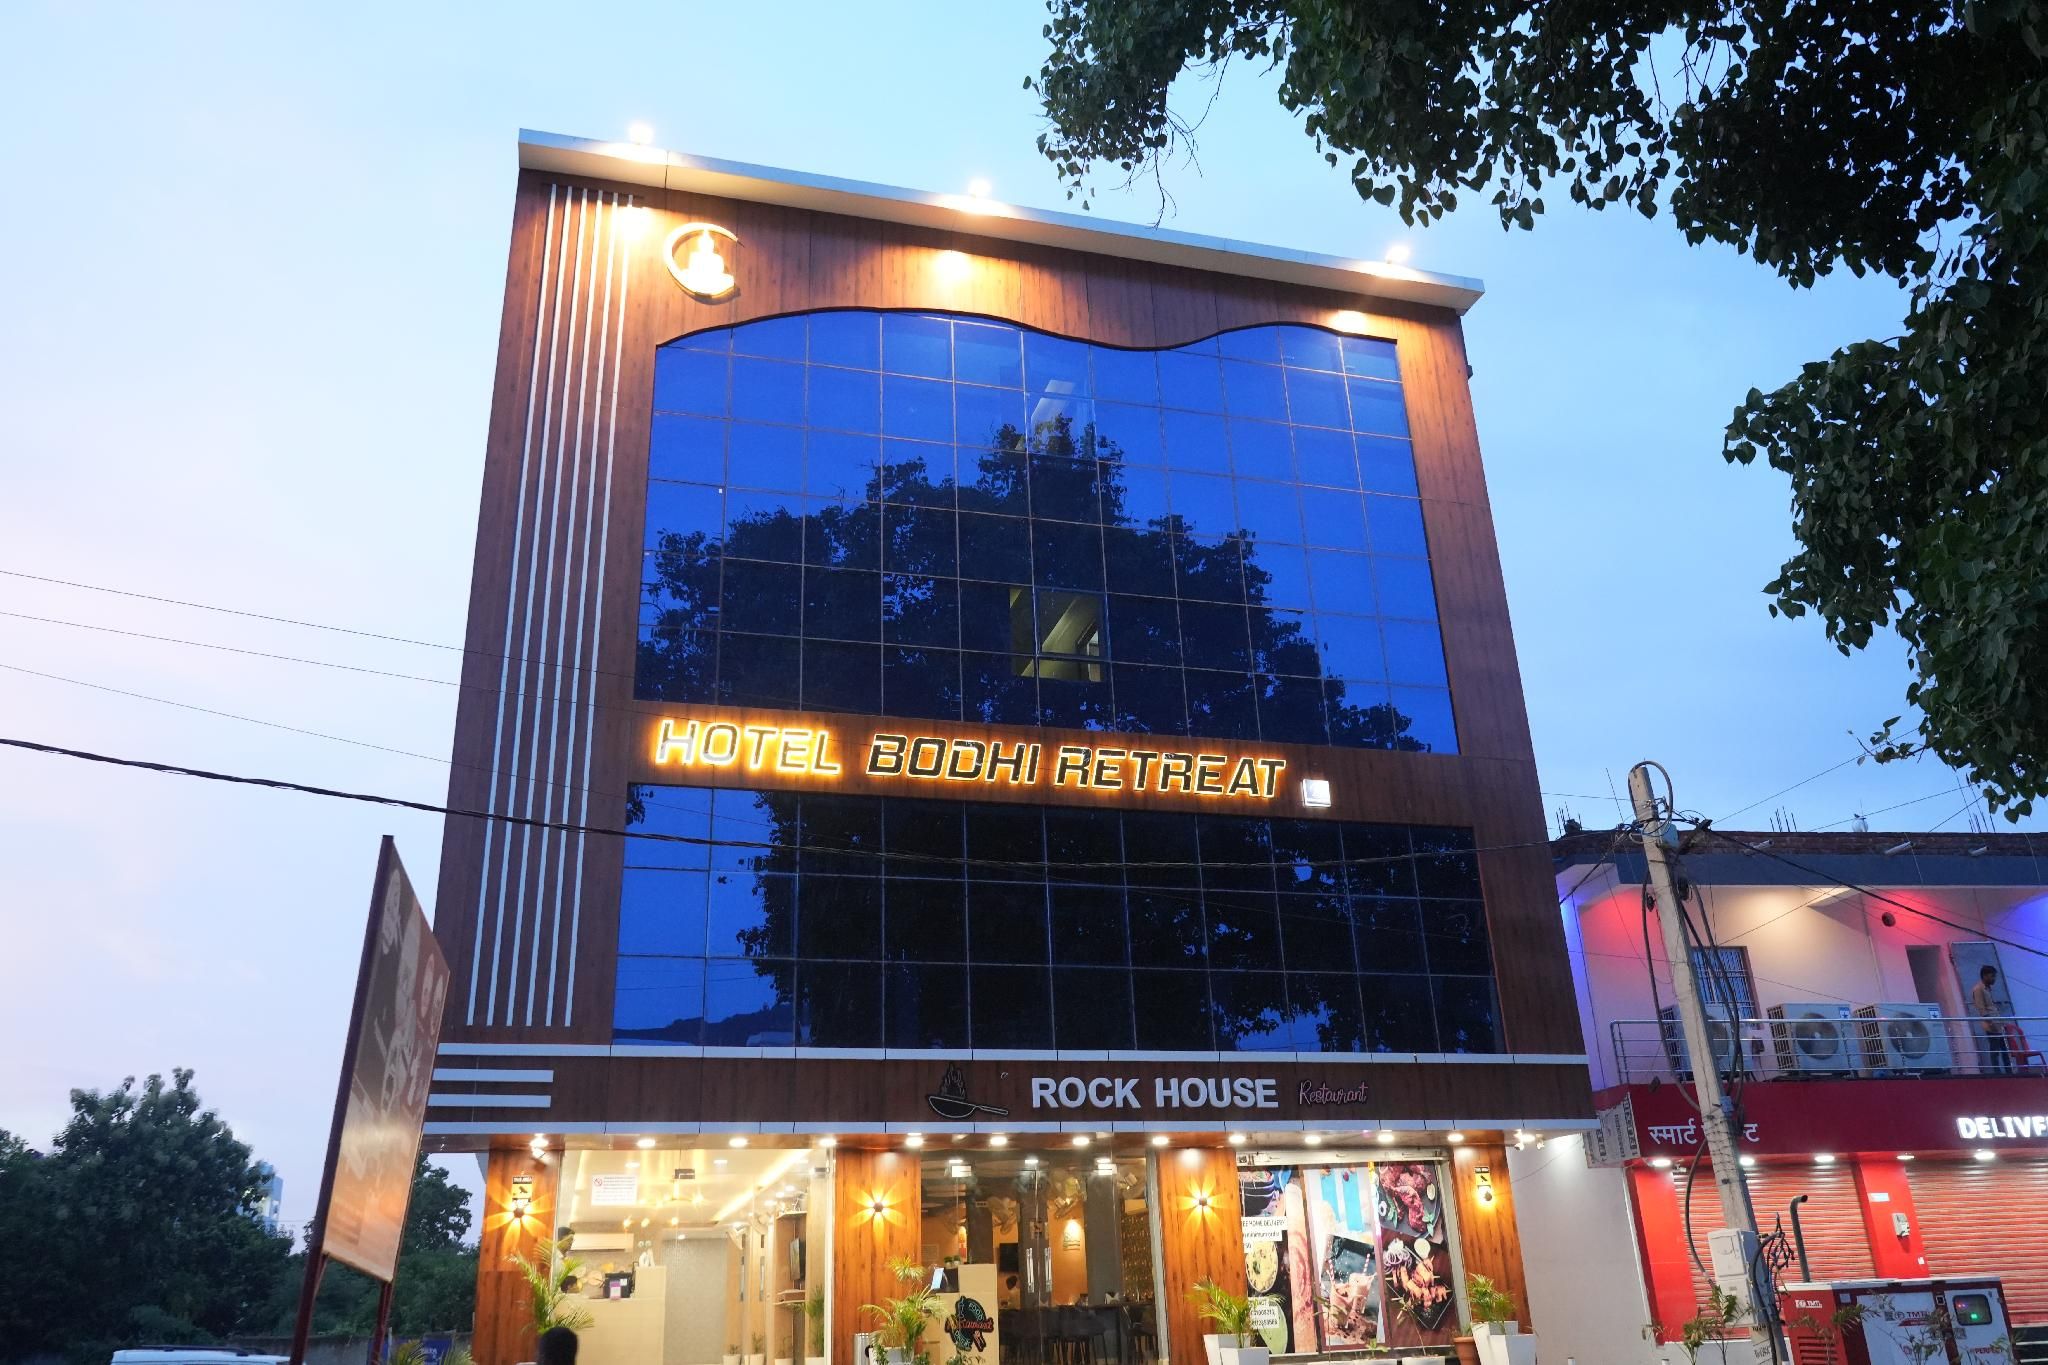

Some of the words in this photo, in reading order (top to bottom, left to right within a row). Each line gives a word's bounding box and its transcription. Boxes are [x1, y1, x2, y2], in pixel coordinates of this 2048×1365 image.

[655, 718, 842, 776] HOTEL
[866, 734, 1038, 785] BODHI
[1055, 745, 1288, 798] RETREAT
[1031, 1077, 1141, 1108] ROCK
[1155, 1077, 1280, 1109] HOUSE
[1298, 1080, 1369, 1106] Restaurant
[1647, 1118, 1698, 1145] स्मार्ट
[1956, 1116, 2048, 1138] DELIVE
